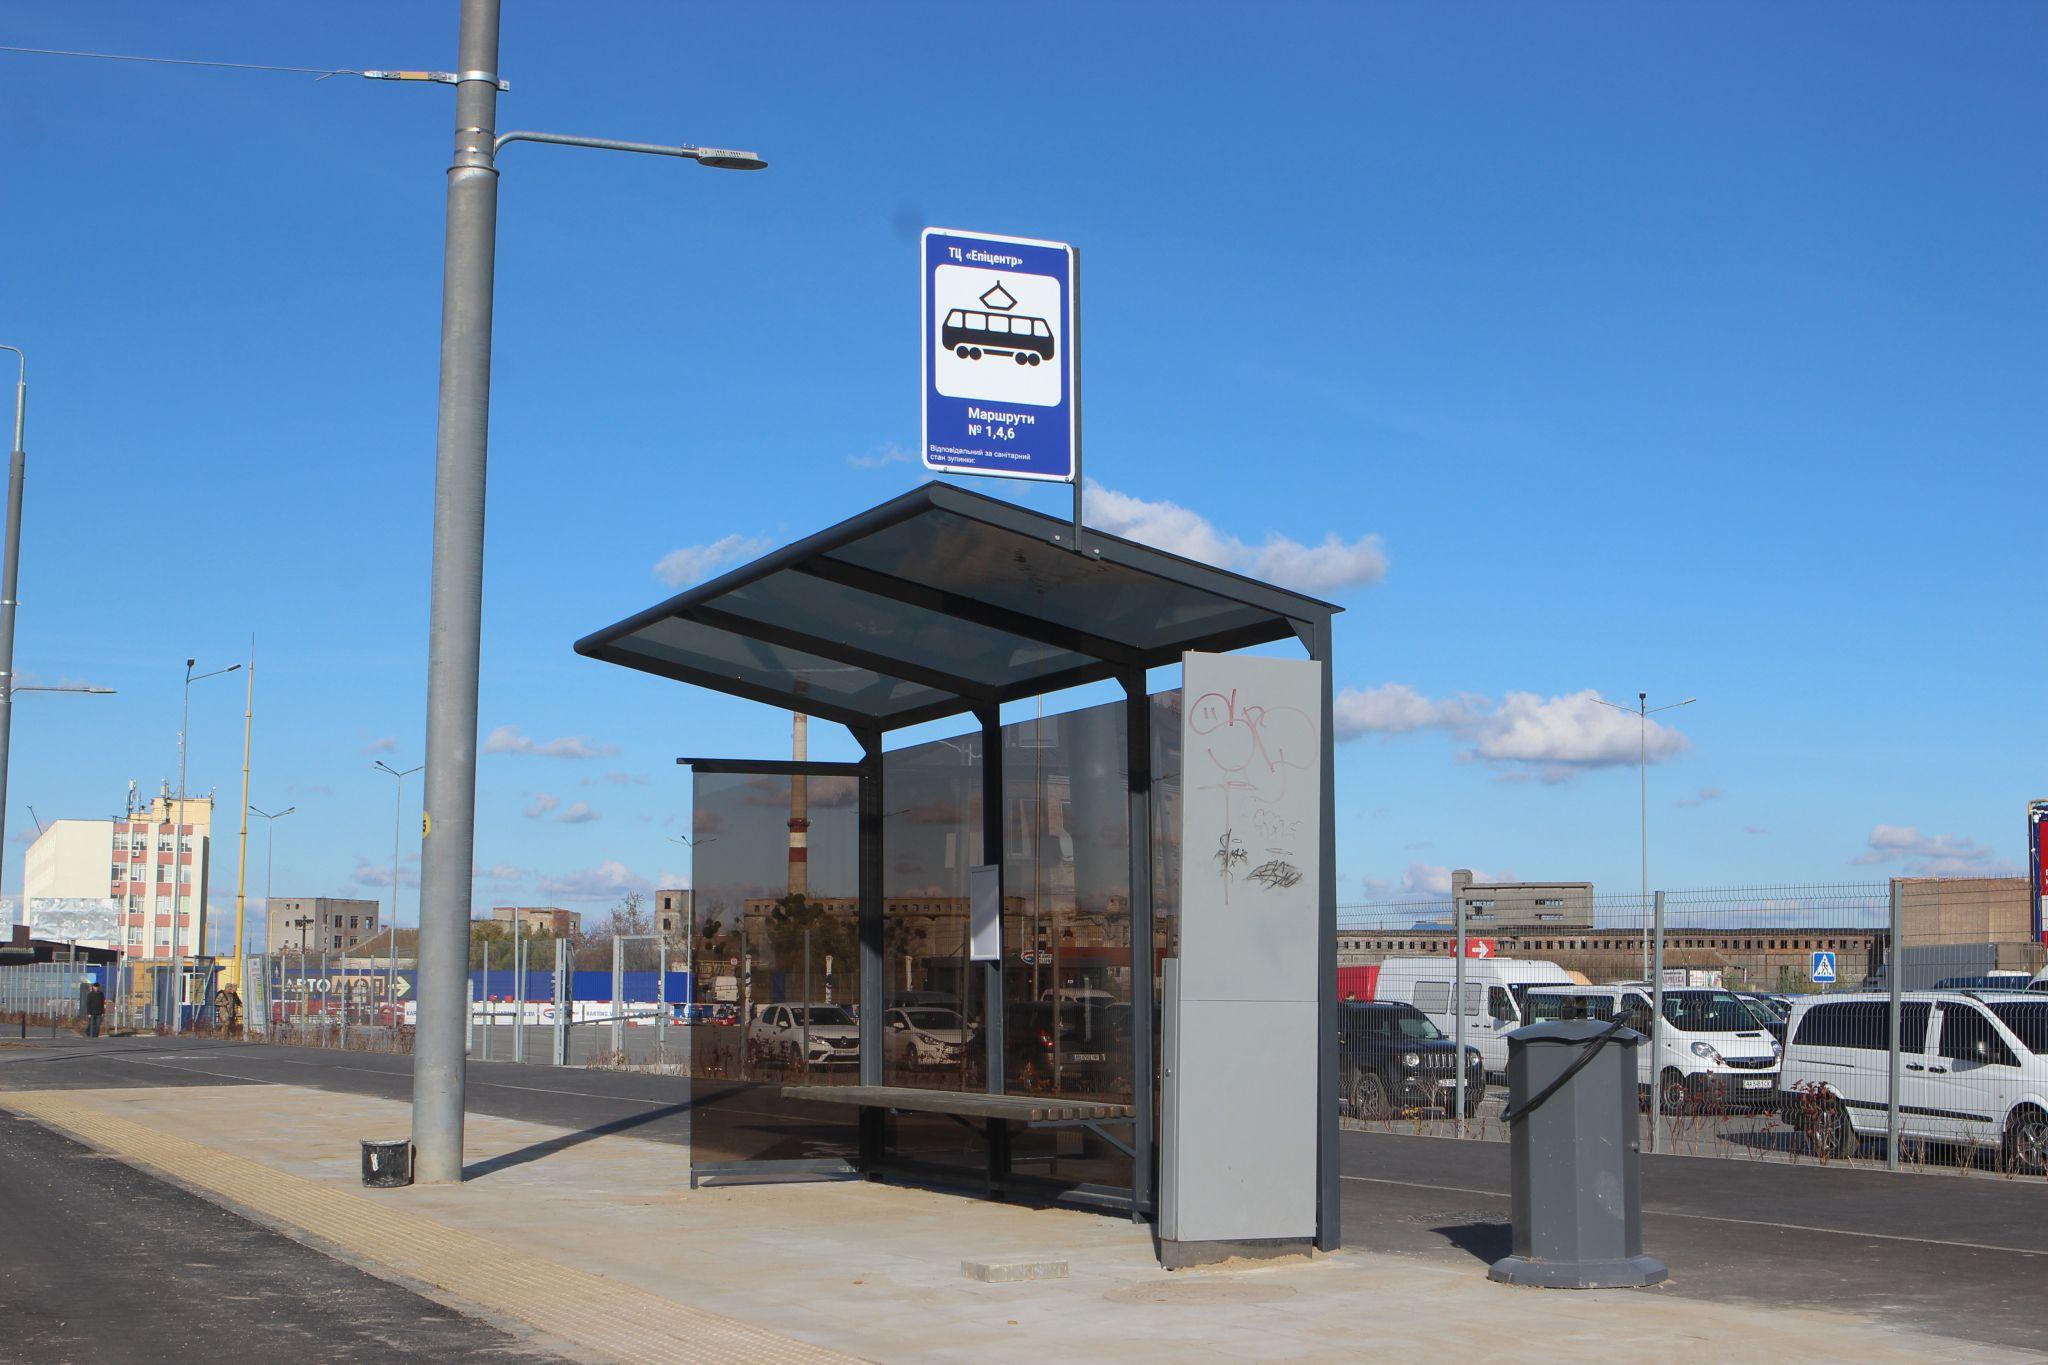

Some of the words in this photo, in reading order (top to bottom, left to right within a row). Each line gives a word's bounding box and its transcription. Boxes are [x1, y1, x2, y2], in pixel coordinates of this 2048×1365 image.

[948, 246, 962, 262] ТЦ
[965, 249, 1023, 268] «Епіцентр»
[968, 407, 1035, 426] Маршрути
[985, 425, 1016, 441] 1,4,6
[930, 444, 984, 456] Відповідальний
[993, 451, 1031, 461] санітарний
[947, 456, 976, 464] зупинки:
